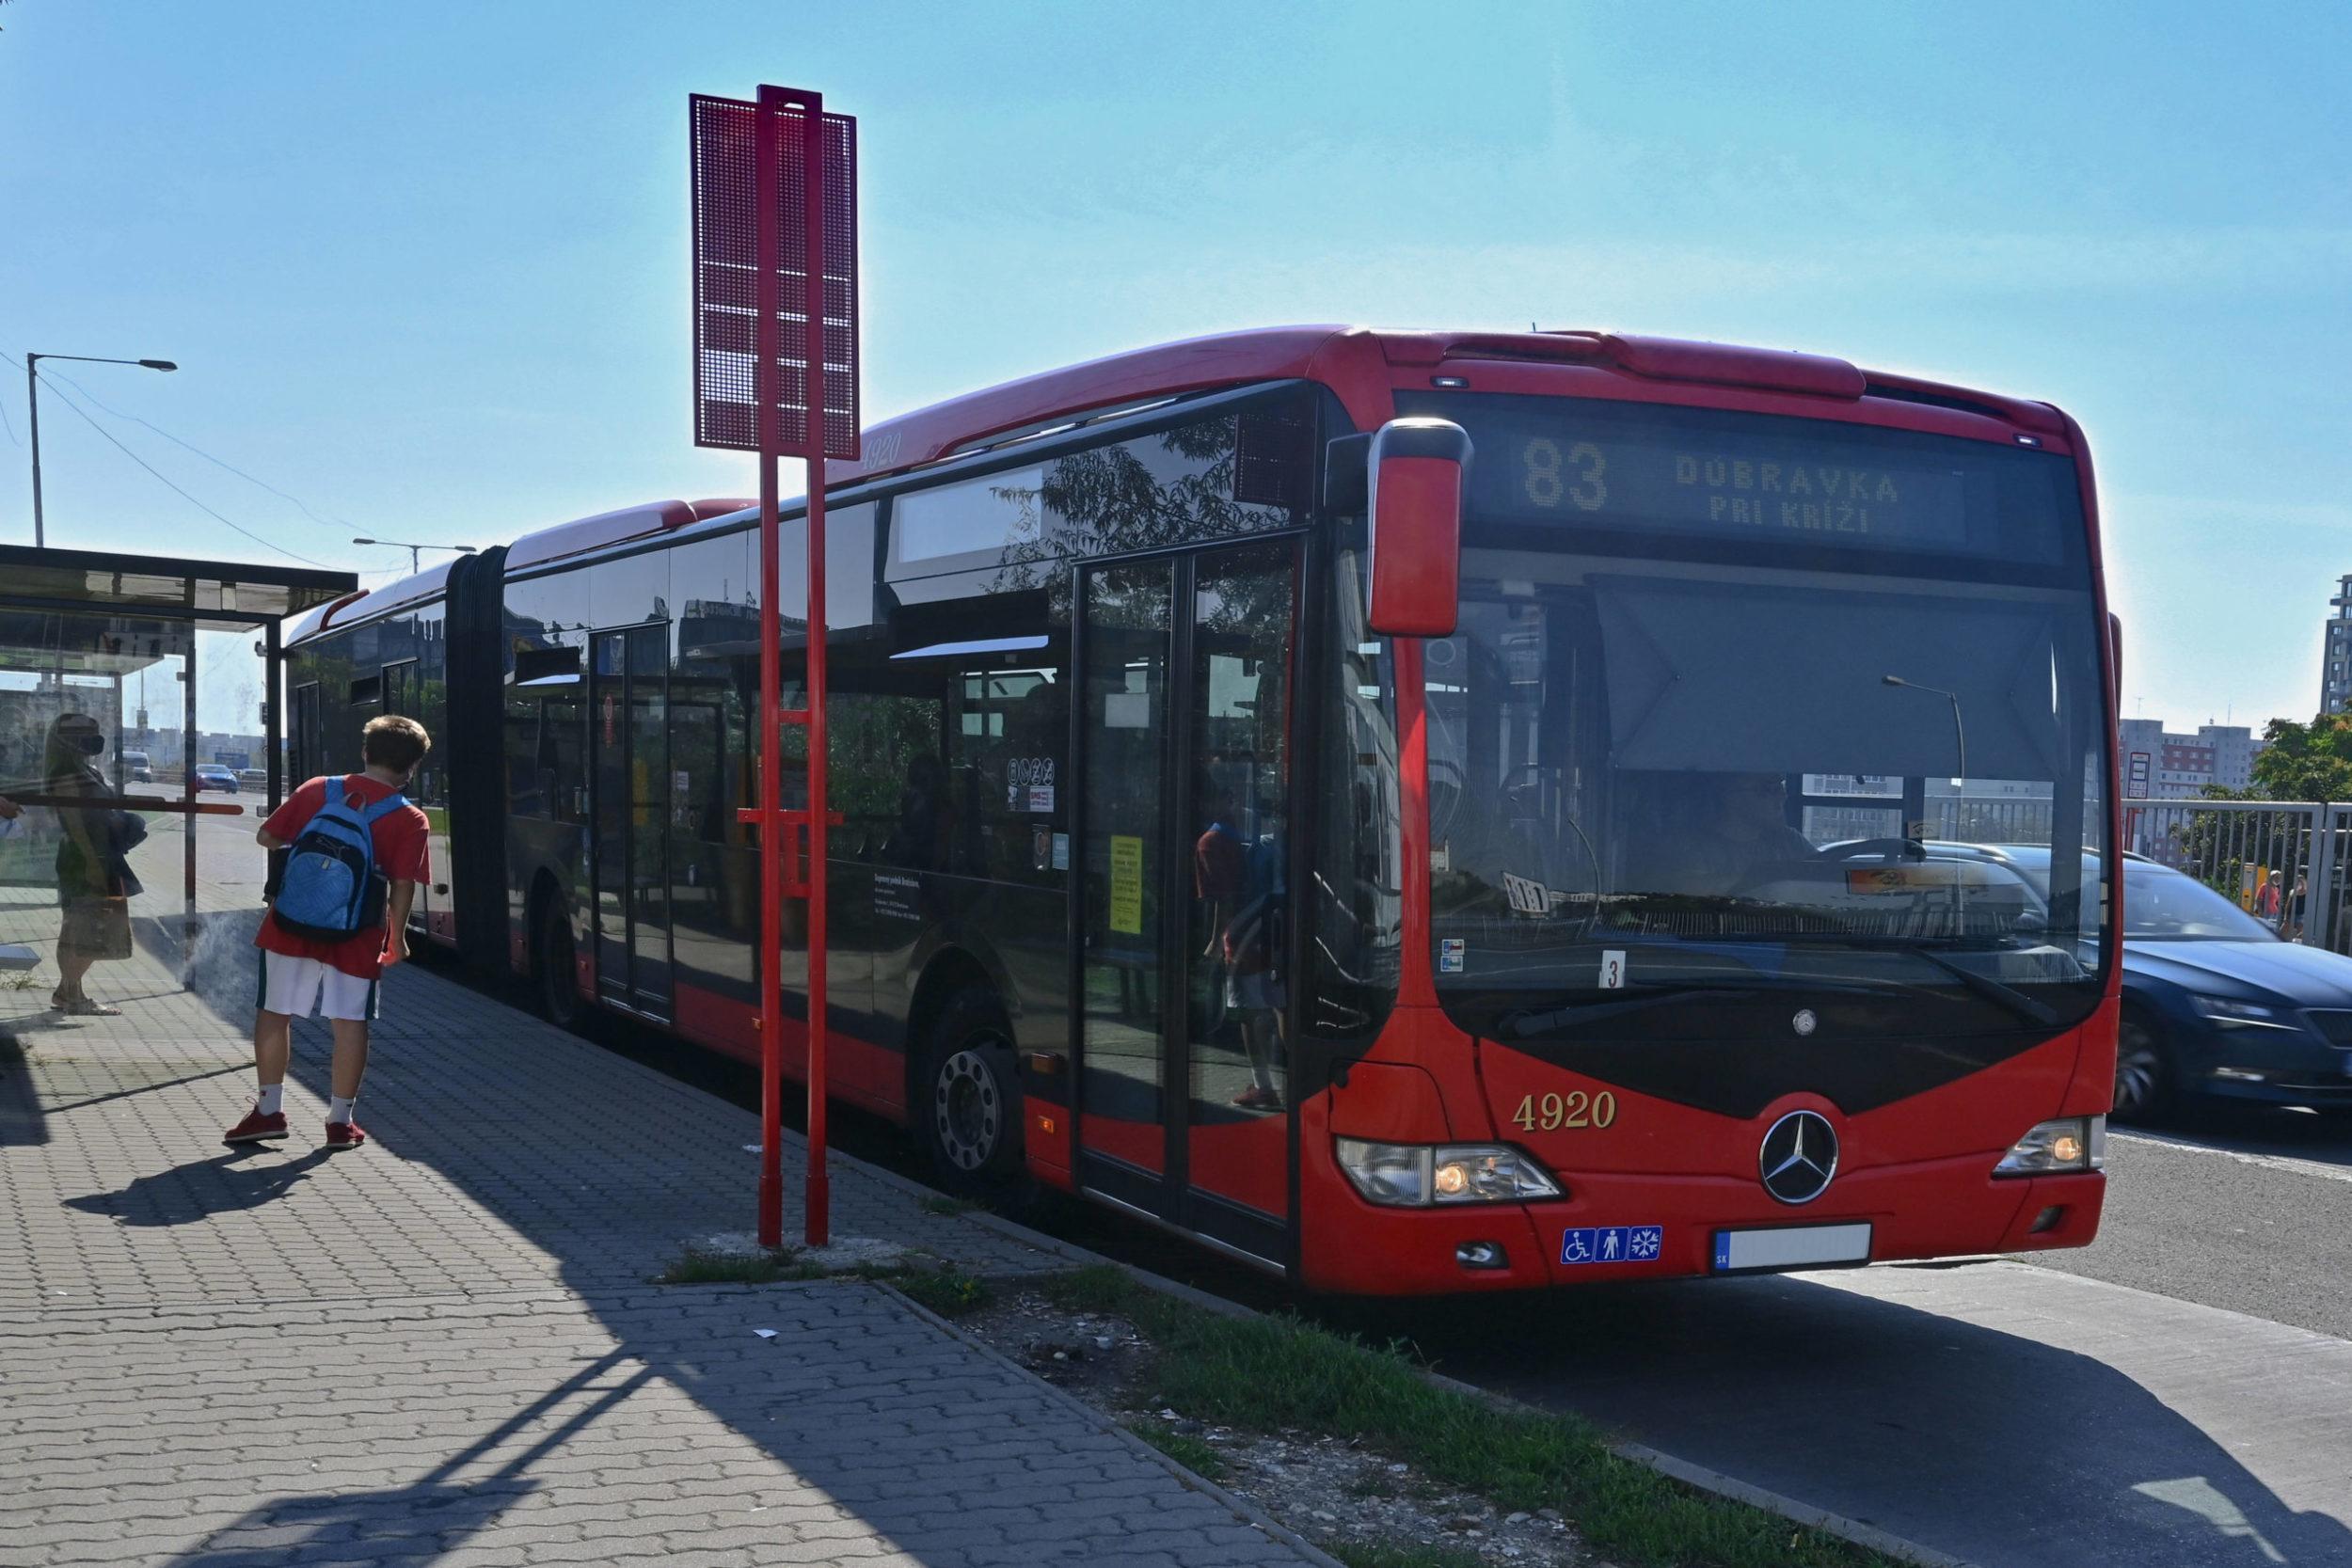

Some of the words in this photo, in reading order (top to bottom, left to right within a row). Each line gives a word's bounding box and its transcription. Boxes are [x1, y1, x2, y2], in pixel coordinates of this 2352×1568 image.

[864, 432, 902, 470] 4920
[1523, 438, 1608, 511] 83
[1676, 455, 1898, 502] DÚBRAVKA
[1708, 496, 1762, 525] PRI
[1781, 499, 1867, 533] KRÍŽI
[1608, 959, 1618, 988] 3
[1512, 1091, 1616, 1131] 4920
[1715, 1255, 1728, 1264] SK
